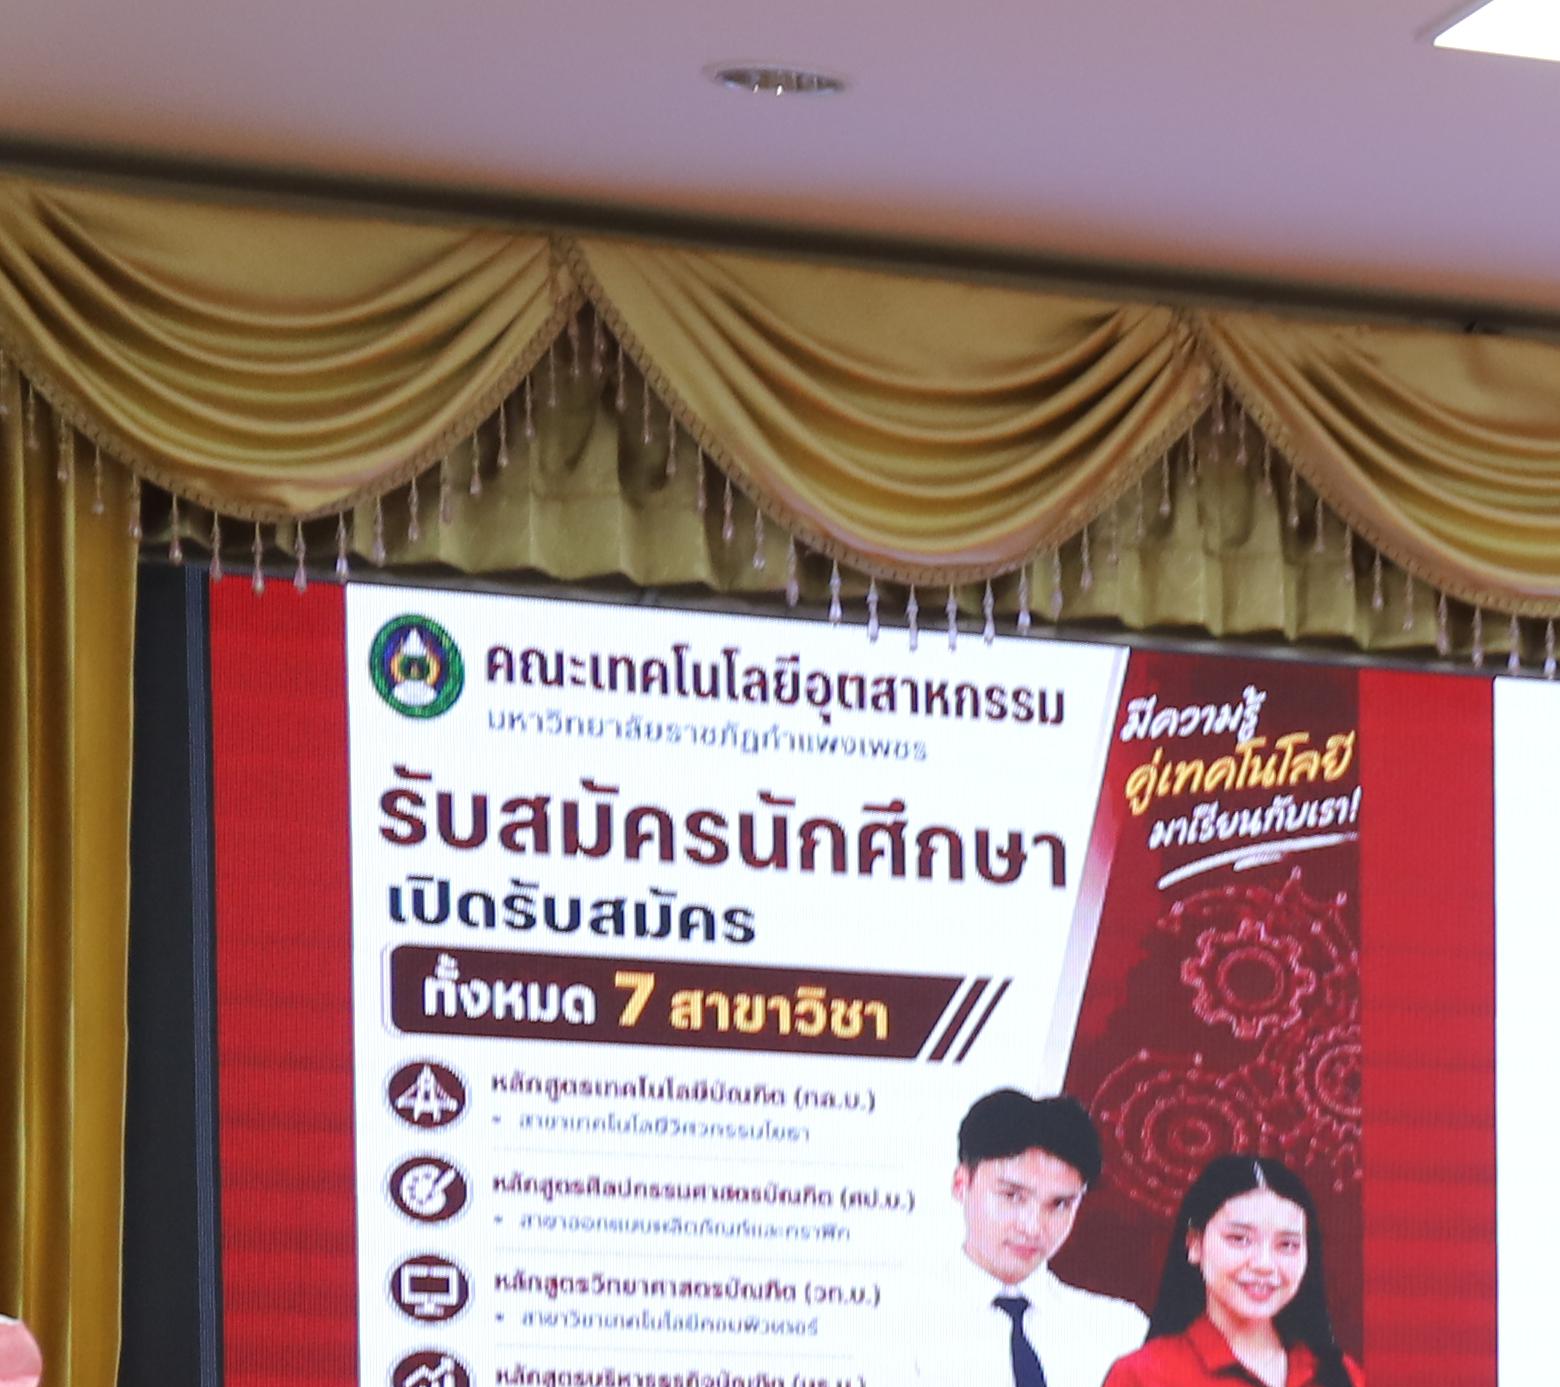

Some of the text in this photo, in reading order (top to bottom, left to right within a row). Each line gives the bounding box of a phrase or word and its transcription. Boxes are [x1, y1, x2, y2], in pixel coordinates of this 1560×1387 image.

[485, 639, 1068, 730] คณะเทคโนโลยีอุตสาหกรรม
[378, 763, 1070, 890] รับสมัครนักศึกษา
[388, 874, 757, 945] เปิดรับสมัคร
[423, 952, 890, 1041] ทั้งหมด 7 สาขาวิชา
